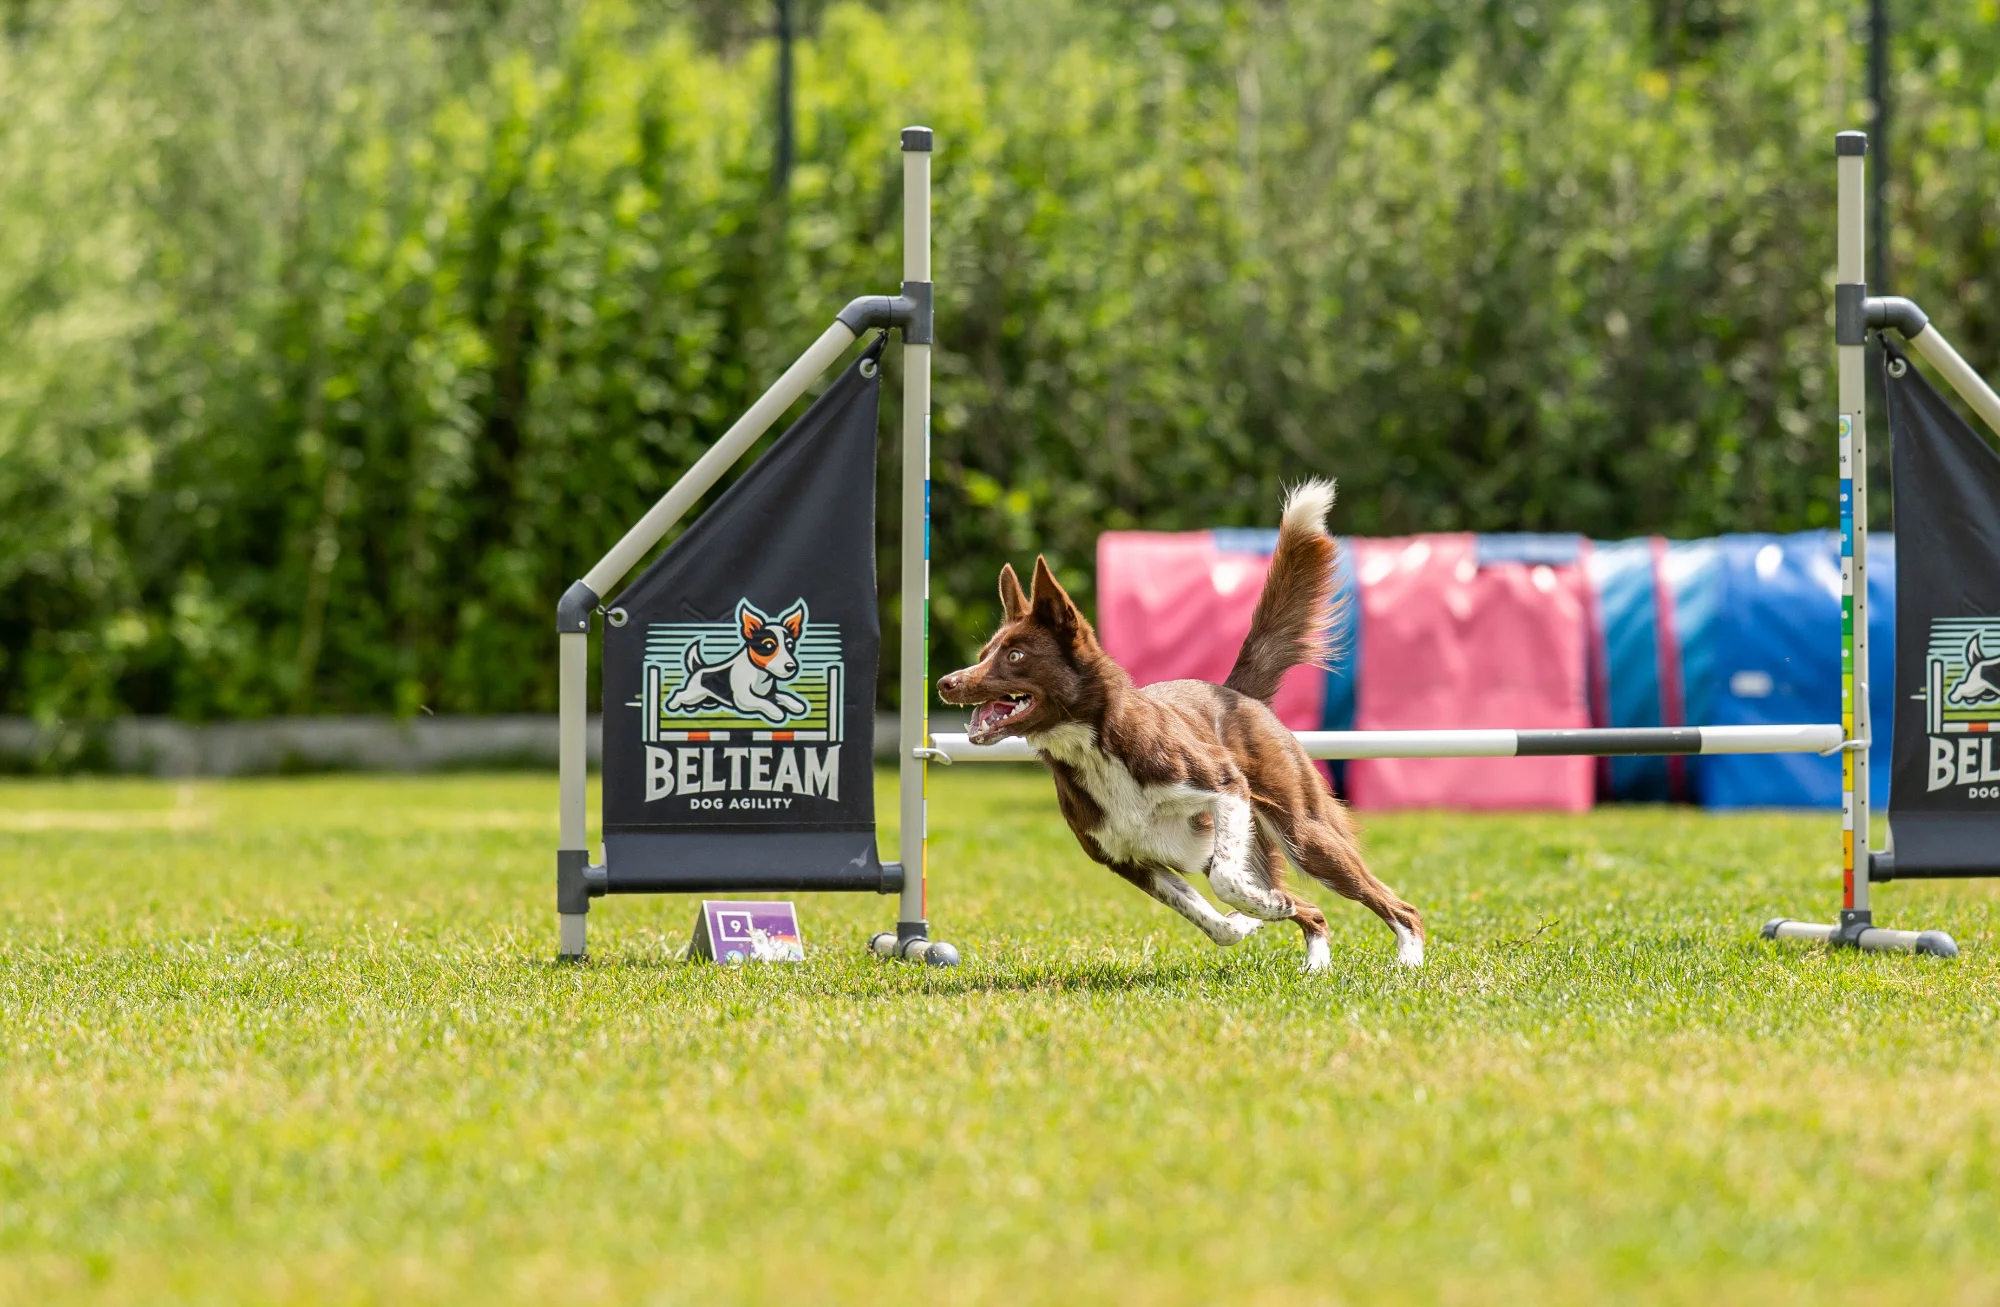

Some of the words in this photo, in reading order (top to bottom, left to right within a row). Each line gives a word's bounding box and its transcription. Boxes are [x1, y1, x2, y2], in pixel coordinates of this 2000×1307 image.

[645, 744, 842, 802] BELTEAM
[1968, 786, 2000, 798] DOG
[690, 798, 723, 809] DOG
[729, 798, 793, 809] AGILITY
[730, 920, 741, 933] 9
